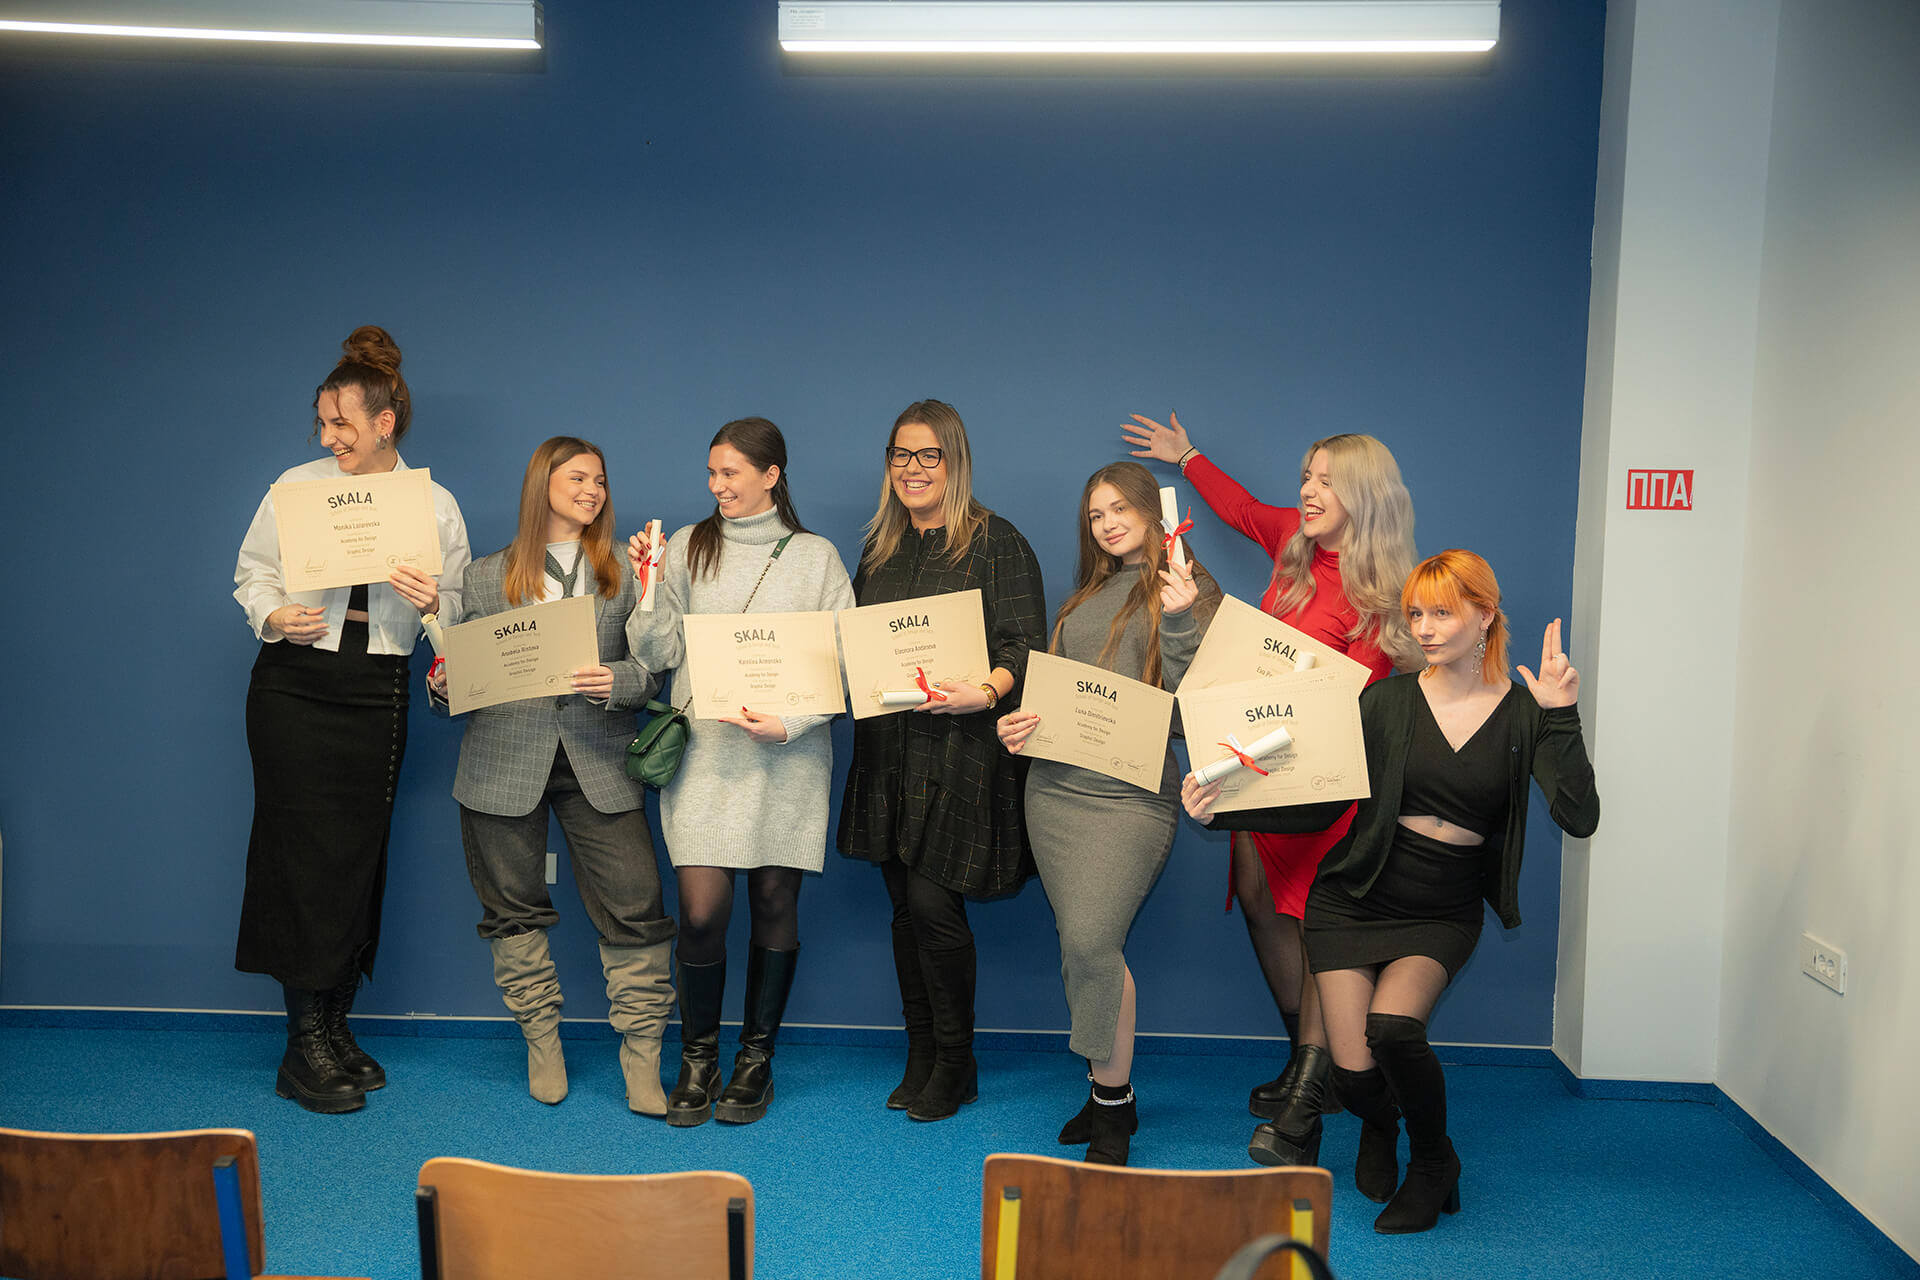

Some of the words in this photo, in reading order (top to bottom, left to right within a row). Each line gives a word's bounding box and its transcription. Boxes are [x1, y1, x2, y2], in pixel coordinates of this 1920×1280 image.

[1629, 473, 1688, 507] ППА
[328, 492, 373, 508] SKALA
[494, 620, 537, 639] SKALA
[889, 615, 930, 632] SKALA
[734, 629, 776, 643] SKALA
[1263, 637, 1297, 663] SKAL
[1076, 680, 1117, 702] SKALA
[1245, 703, 1294, 722] SKALA
